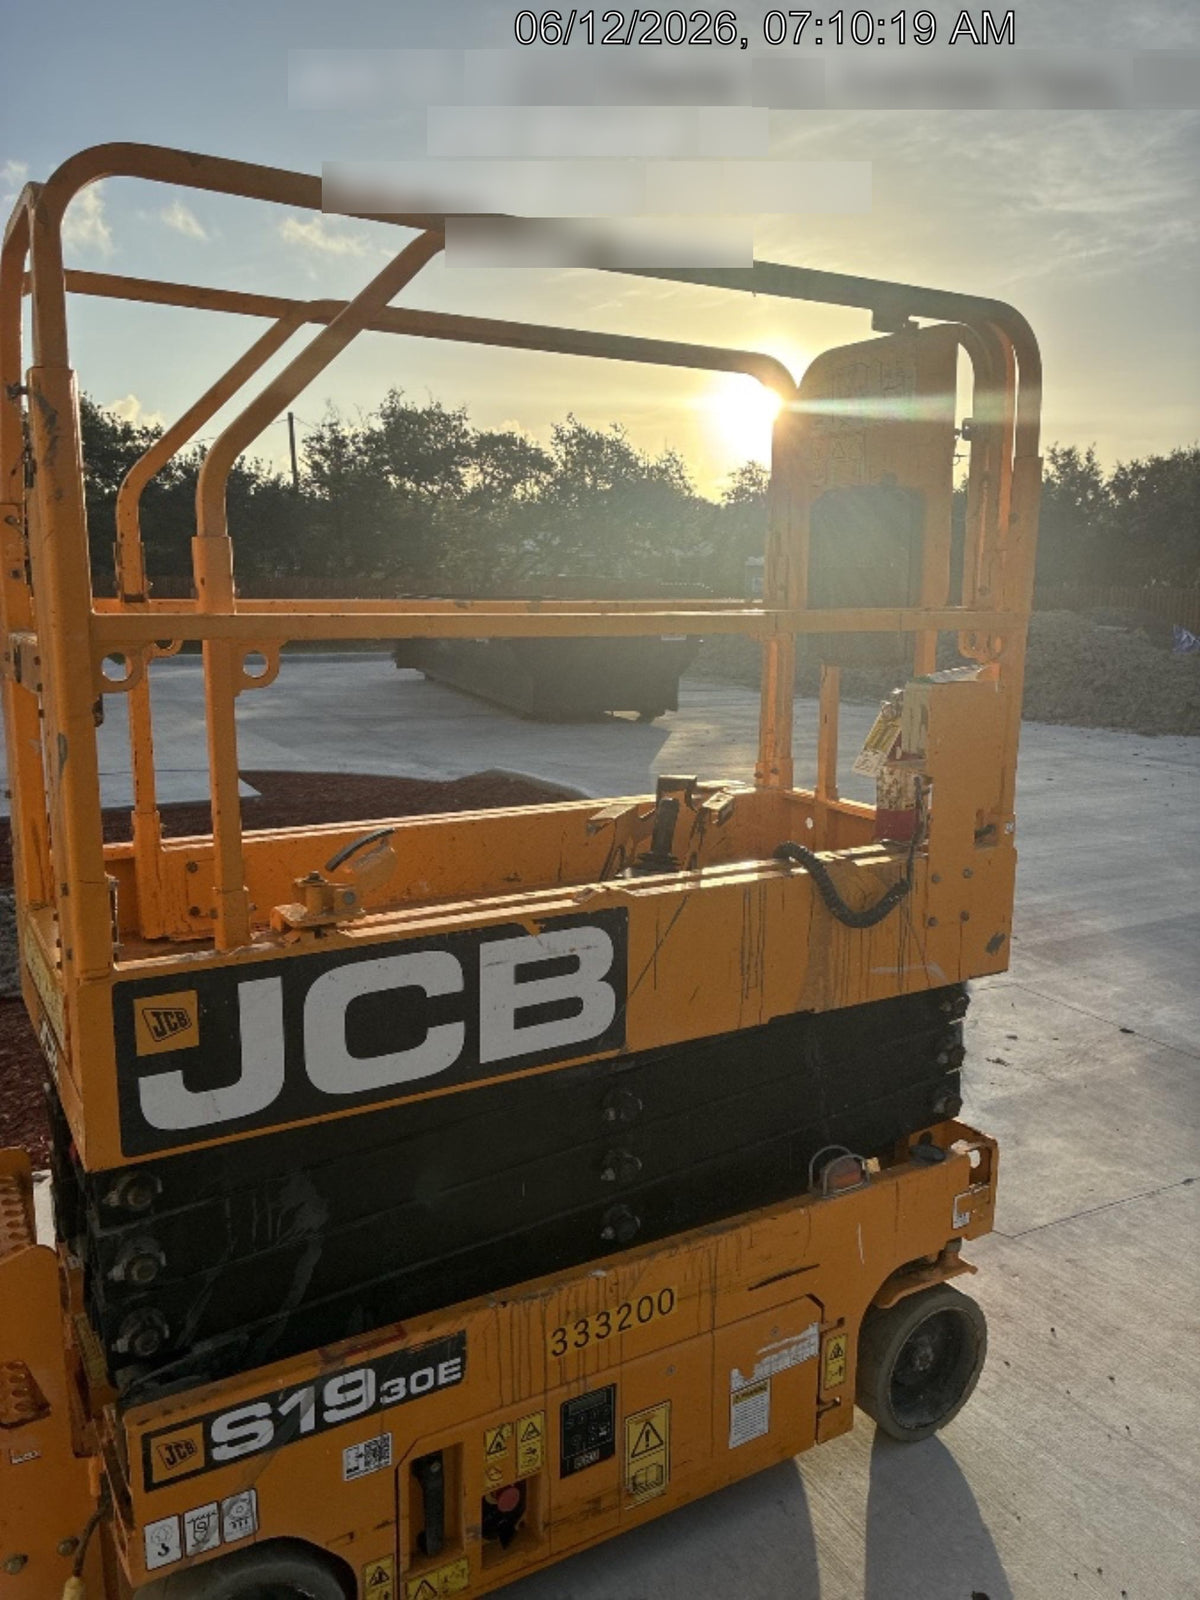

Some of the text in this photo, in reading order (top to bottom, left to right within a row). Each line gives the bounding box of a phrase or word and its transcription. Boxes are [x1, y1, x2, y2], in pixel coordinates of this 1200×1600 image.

[138, 926, 616, 1131] JCB
[150, 1008, 191, 1040] JCB
[551, 1288, 675, 1358] 333200
[165, 1438, 196, 1468] JCB
